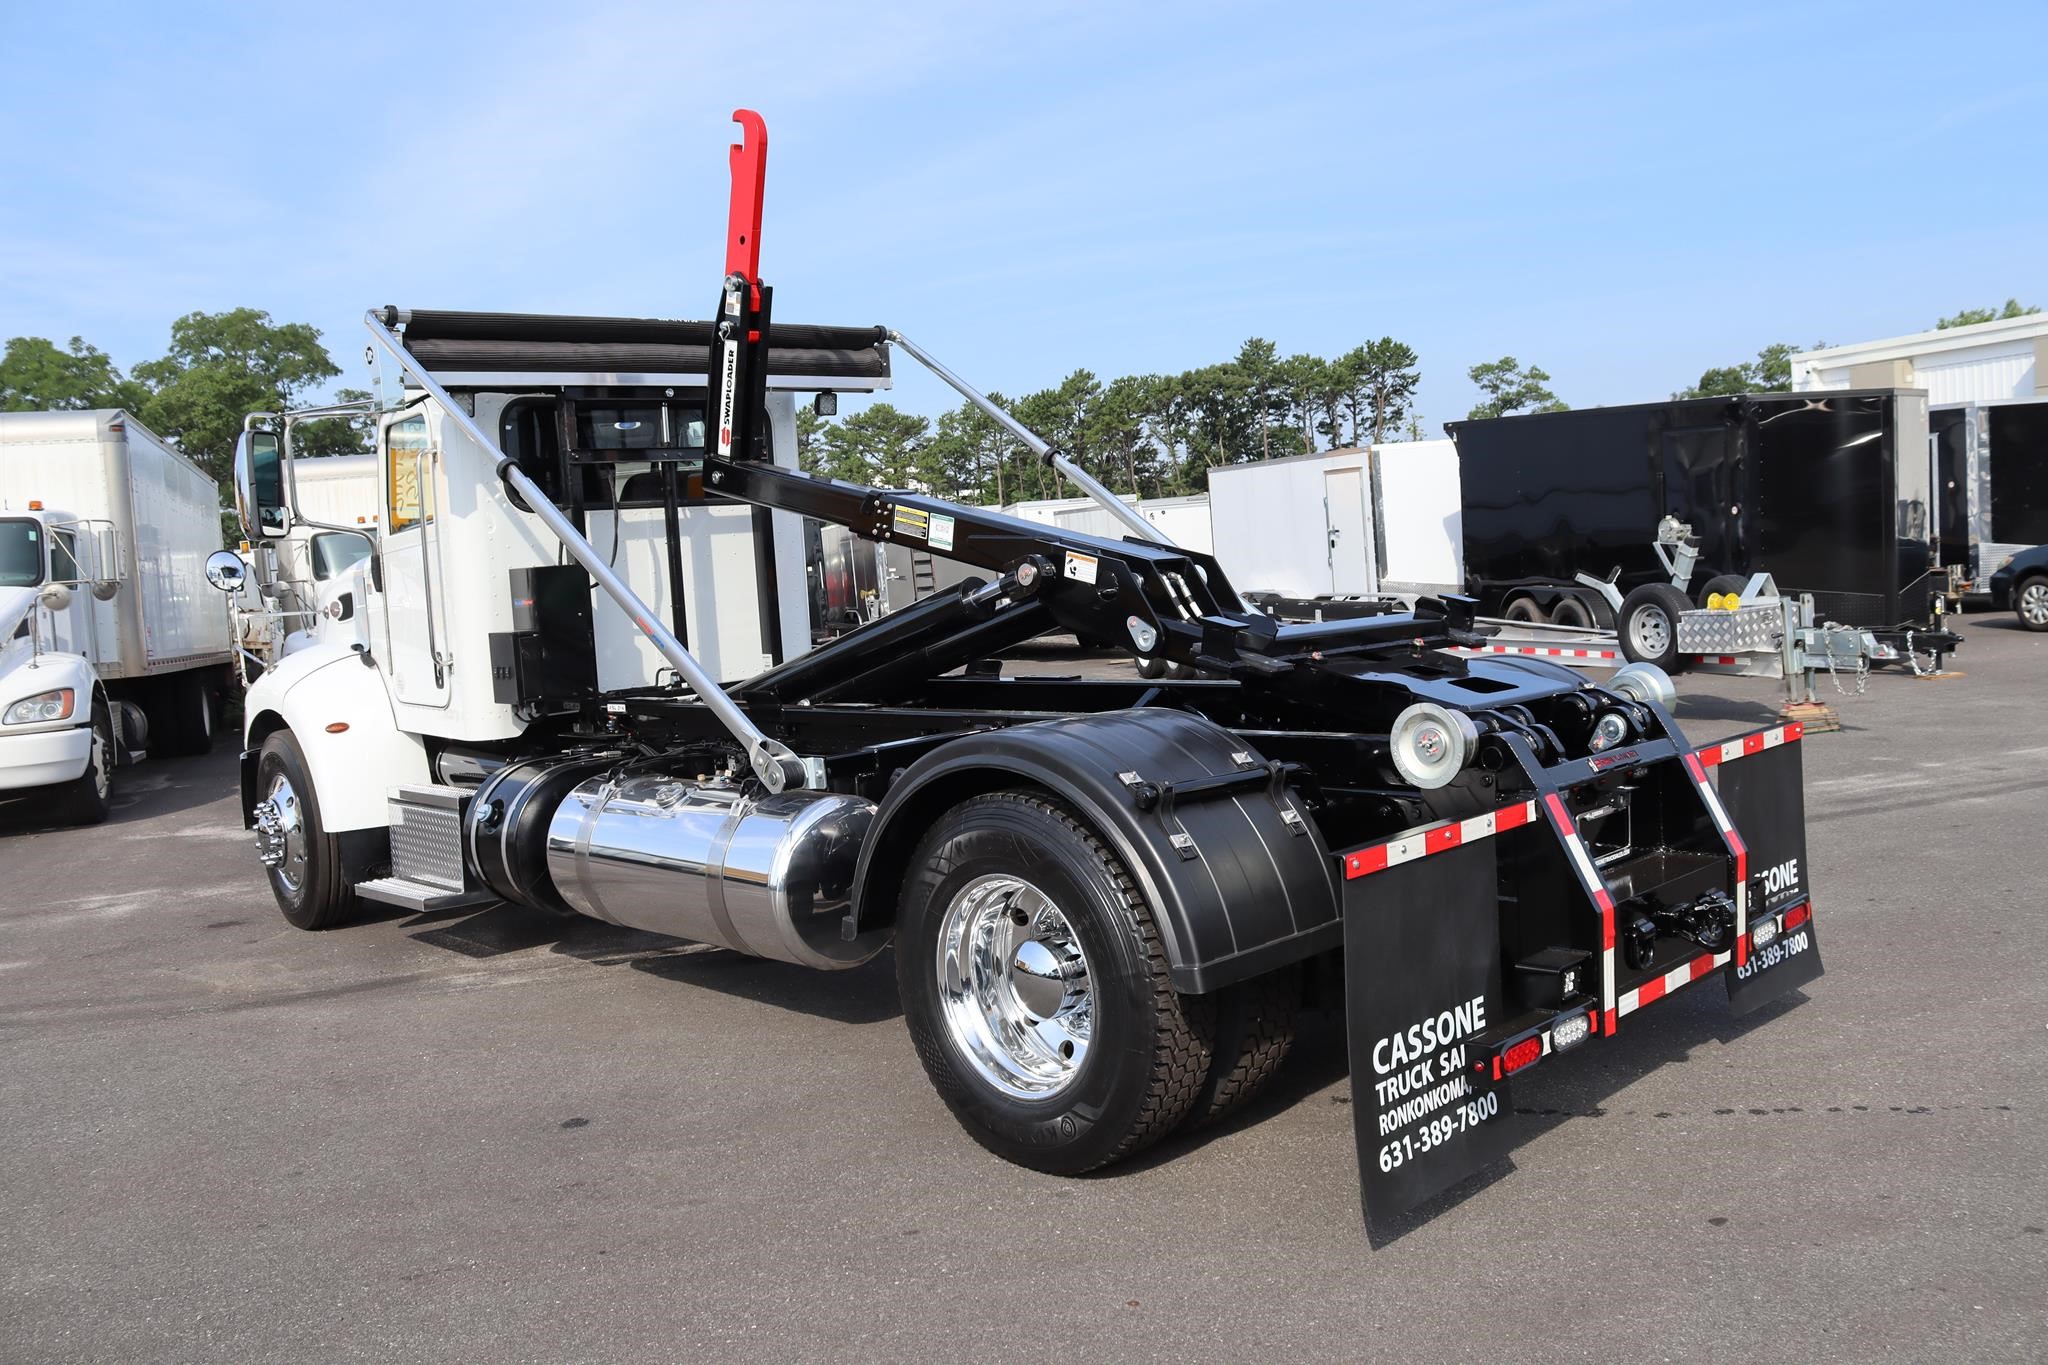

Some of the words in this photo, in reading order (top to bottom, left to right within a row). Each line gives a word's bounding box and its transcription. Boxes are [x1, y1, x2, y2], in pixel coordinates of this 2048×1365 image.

[724, 349, 735, 425] SWAPLOADER
[1372, 995, 1487, 1074] CASSONE
[1375, 1059, 1435, 1106] TRUCK
[1379, 1091, 1498, 1173] 631-389-7800
